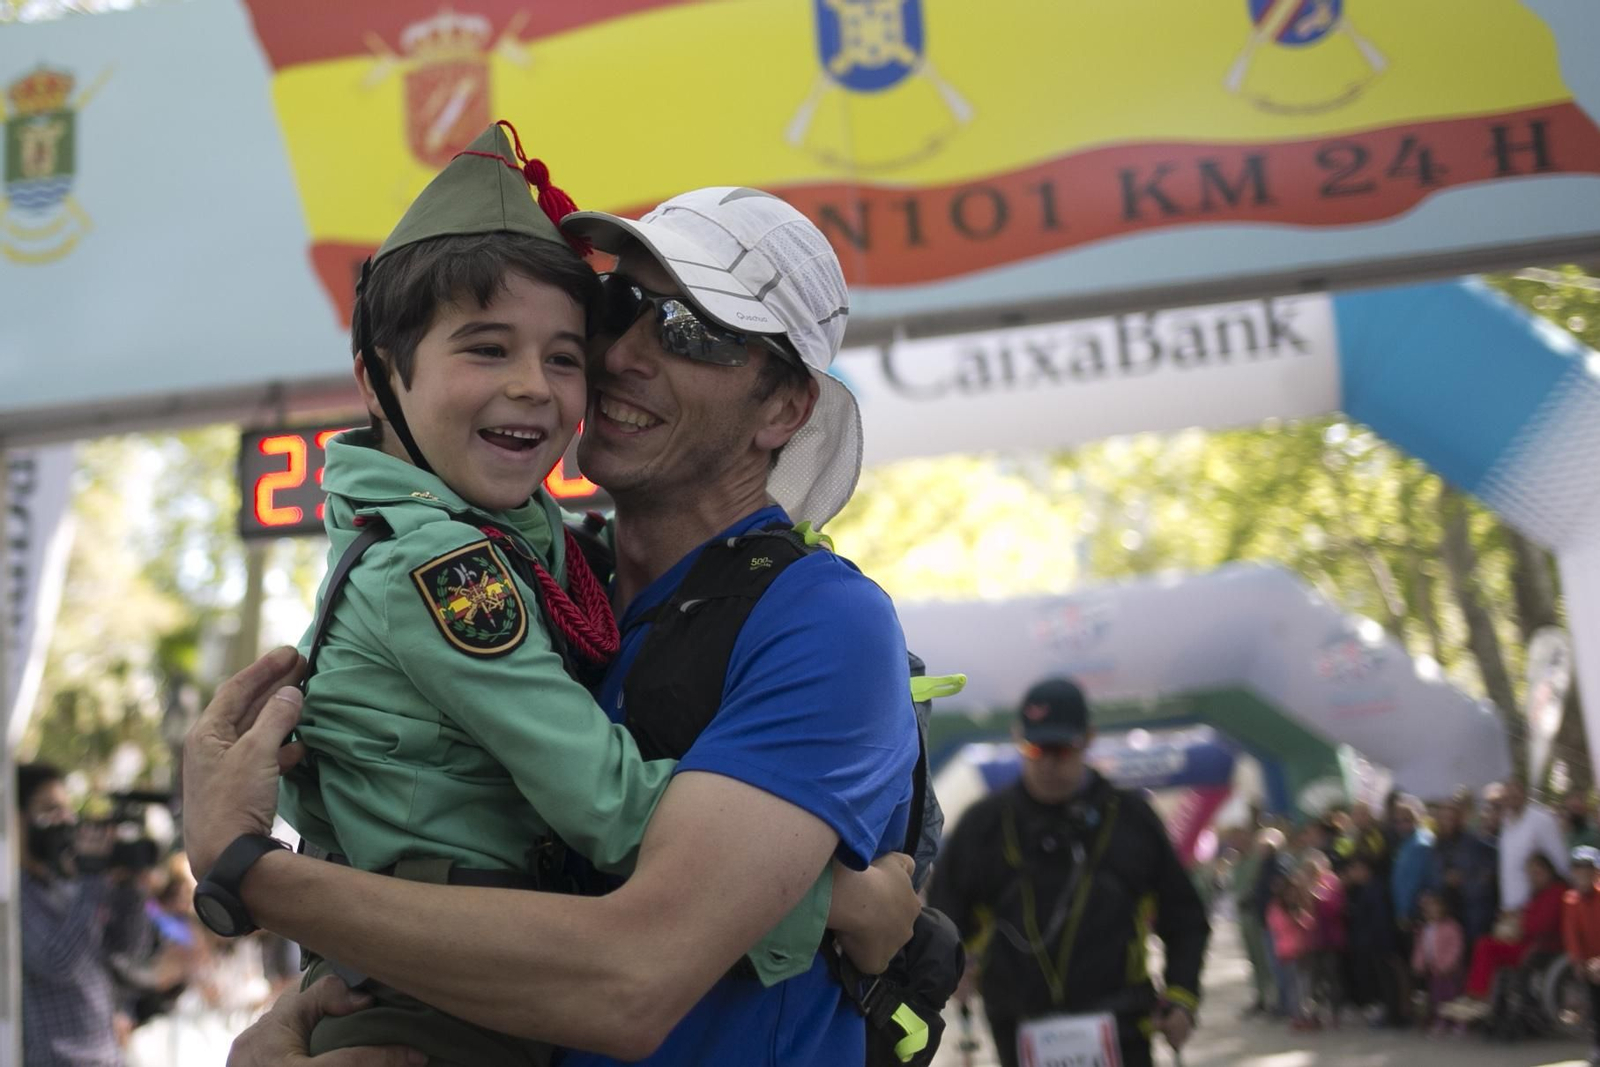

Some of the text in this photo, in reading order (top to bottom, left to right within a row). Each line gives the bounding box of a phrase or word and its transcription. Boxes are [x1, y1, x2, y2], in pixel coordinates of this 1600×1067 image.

[1117, 153, 1278, 222] KM
[1315, 135, 1447, 199] 24
[1489, 120, 1559, 176] H
[879, 300, 1313, 399] CaixaBank
